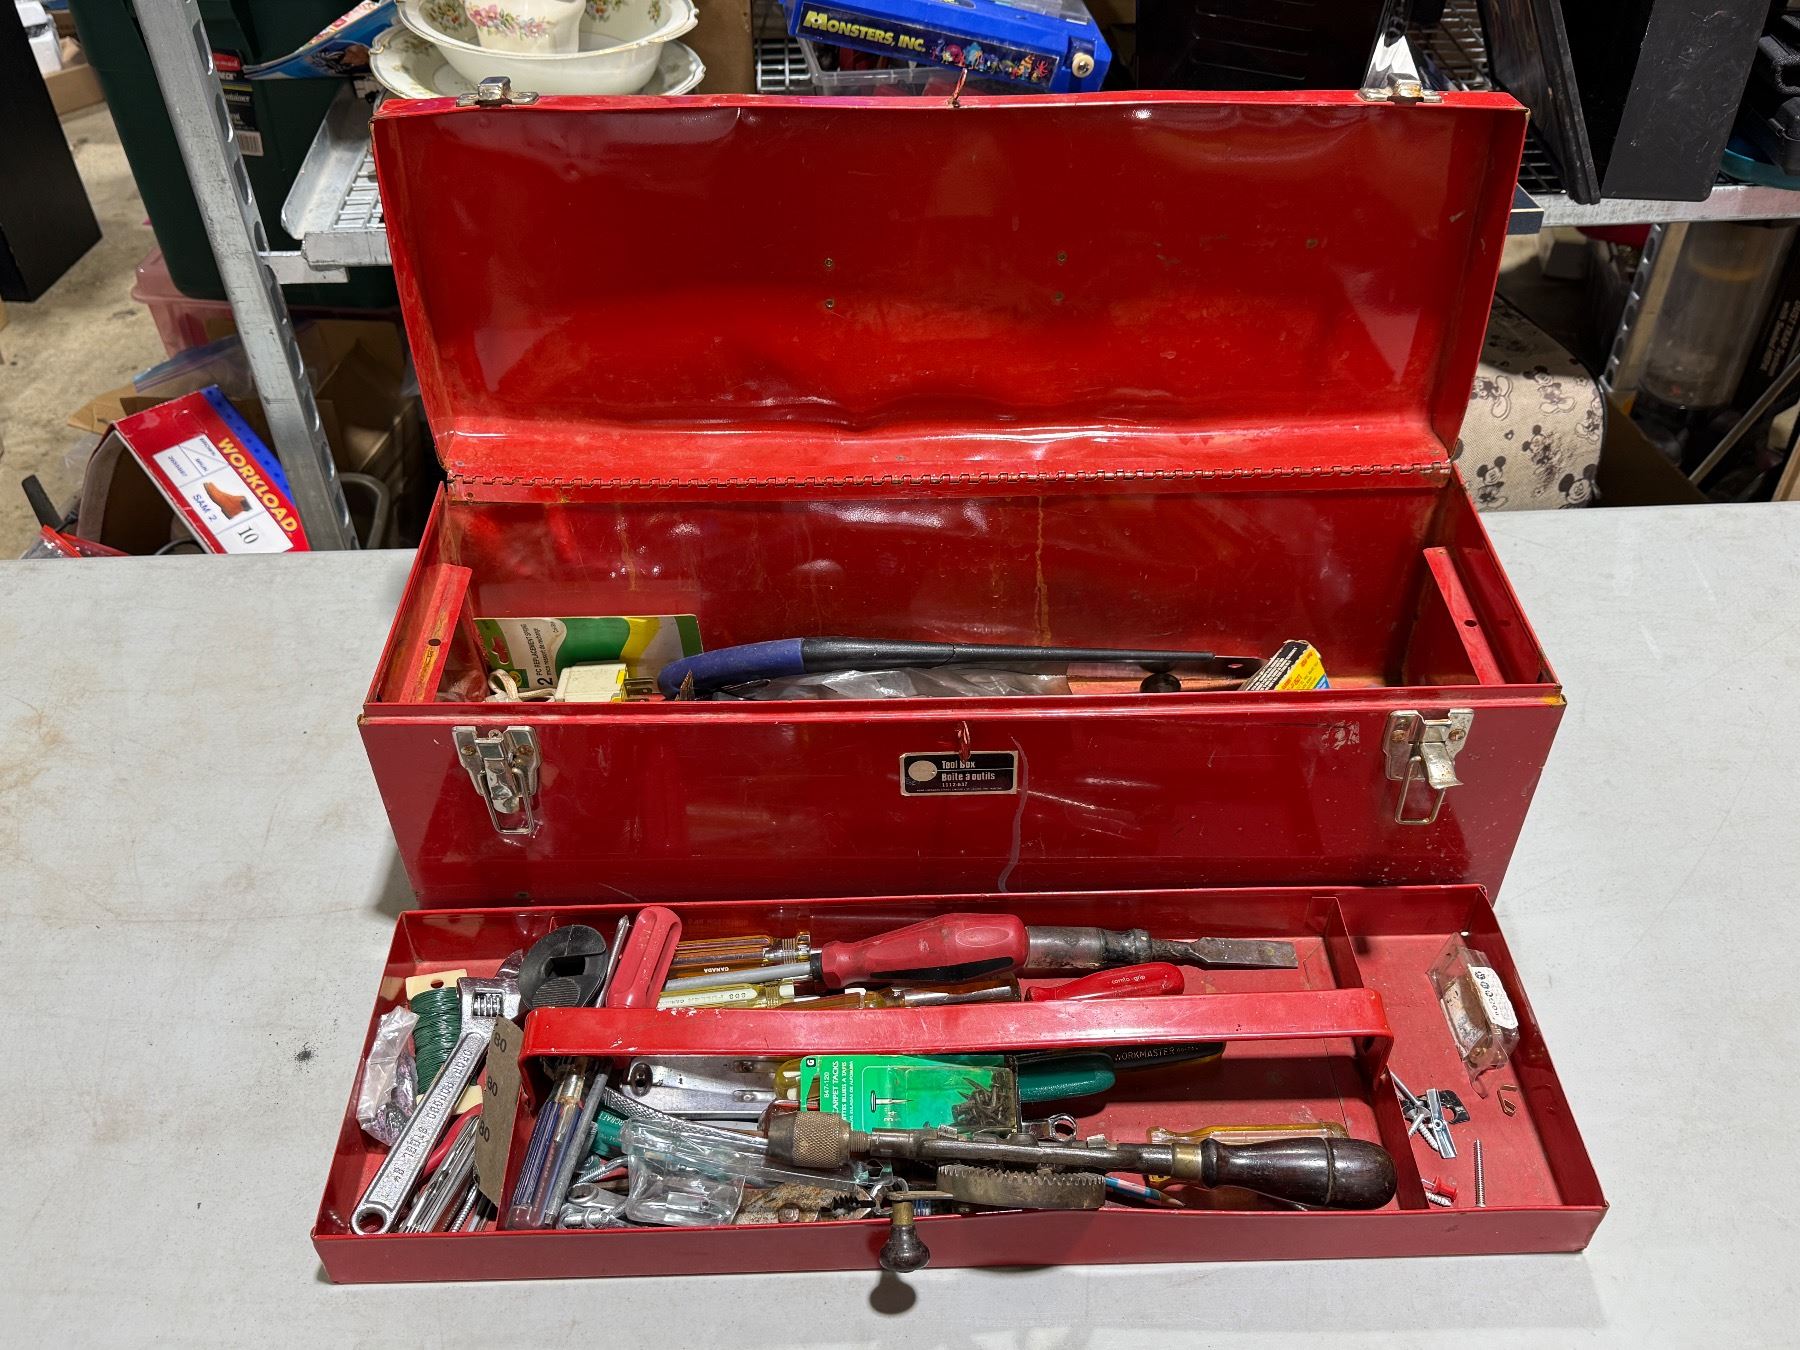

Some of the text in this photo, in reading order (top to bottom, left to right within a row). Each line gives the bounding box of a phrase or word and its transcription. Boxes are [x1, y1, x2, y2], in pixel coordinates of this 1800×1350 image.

[897, 34, 926, 52] INC.
[218, 438, 299, 532] WORKLOAD
[192, 492, 218, 522] SAM 2
[237, 524, 259, 546] 10
[537, 677, 553, 685] 2
[941, 760, 958, 769] Tool
[971, 771, 996, 781] outils
[703, 966, 729, 974] CANADA
[493, 1032, 507, 1053] 80
[1115, 1047, 1175, 1061] WORKMASTER
[487, 1075, 498, 1097] 80
[479, 1119, 490, 1143] 80
